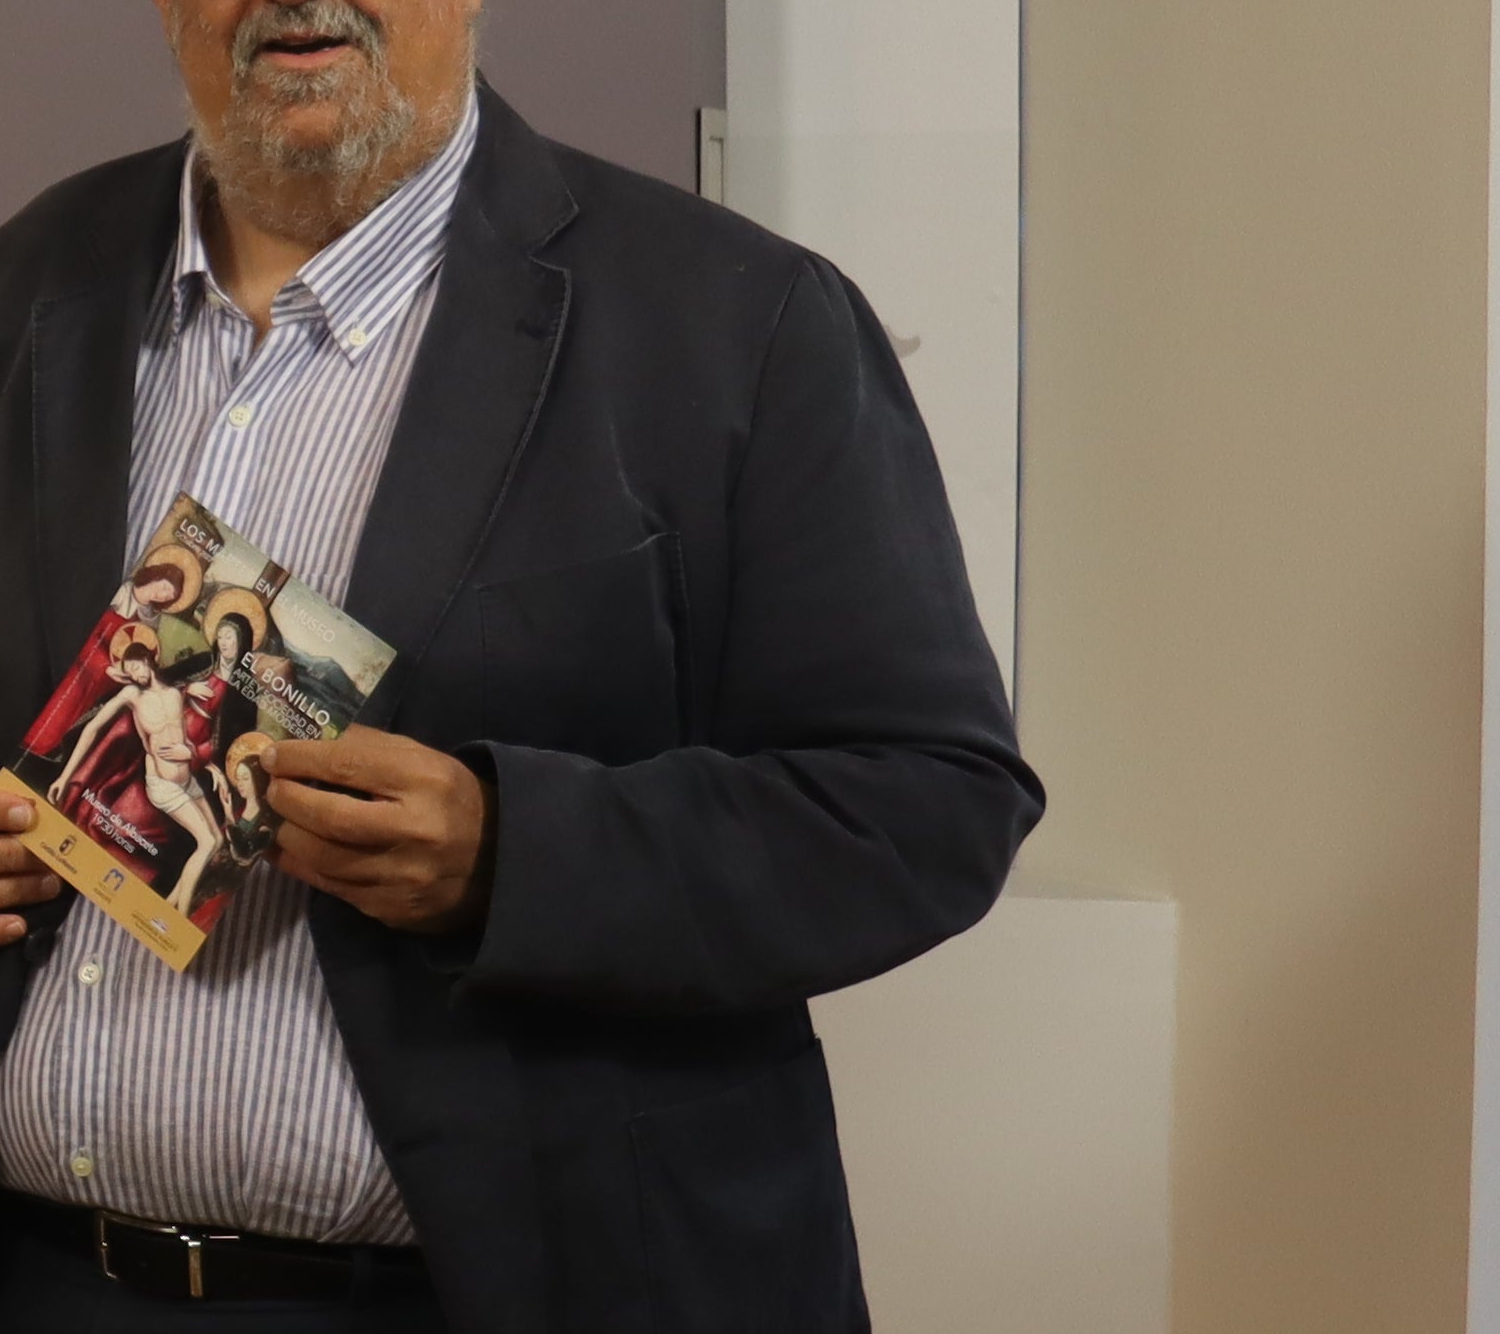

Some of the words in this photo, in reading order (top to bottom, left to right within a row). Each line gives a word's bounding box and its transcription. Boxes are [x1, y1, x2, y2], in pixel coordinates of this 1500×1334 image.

[179, 518, 206, 544] LOS
[254, 578, 276, 599] EN
[240, 651, 259, 675] EL
[261, 668, 331, 726] BONILLO
[305, 723, 322, 739] EN
